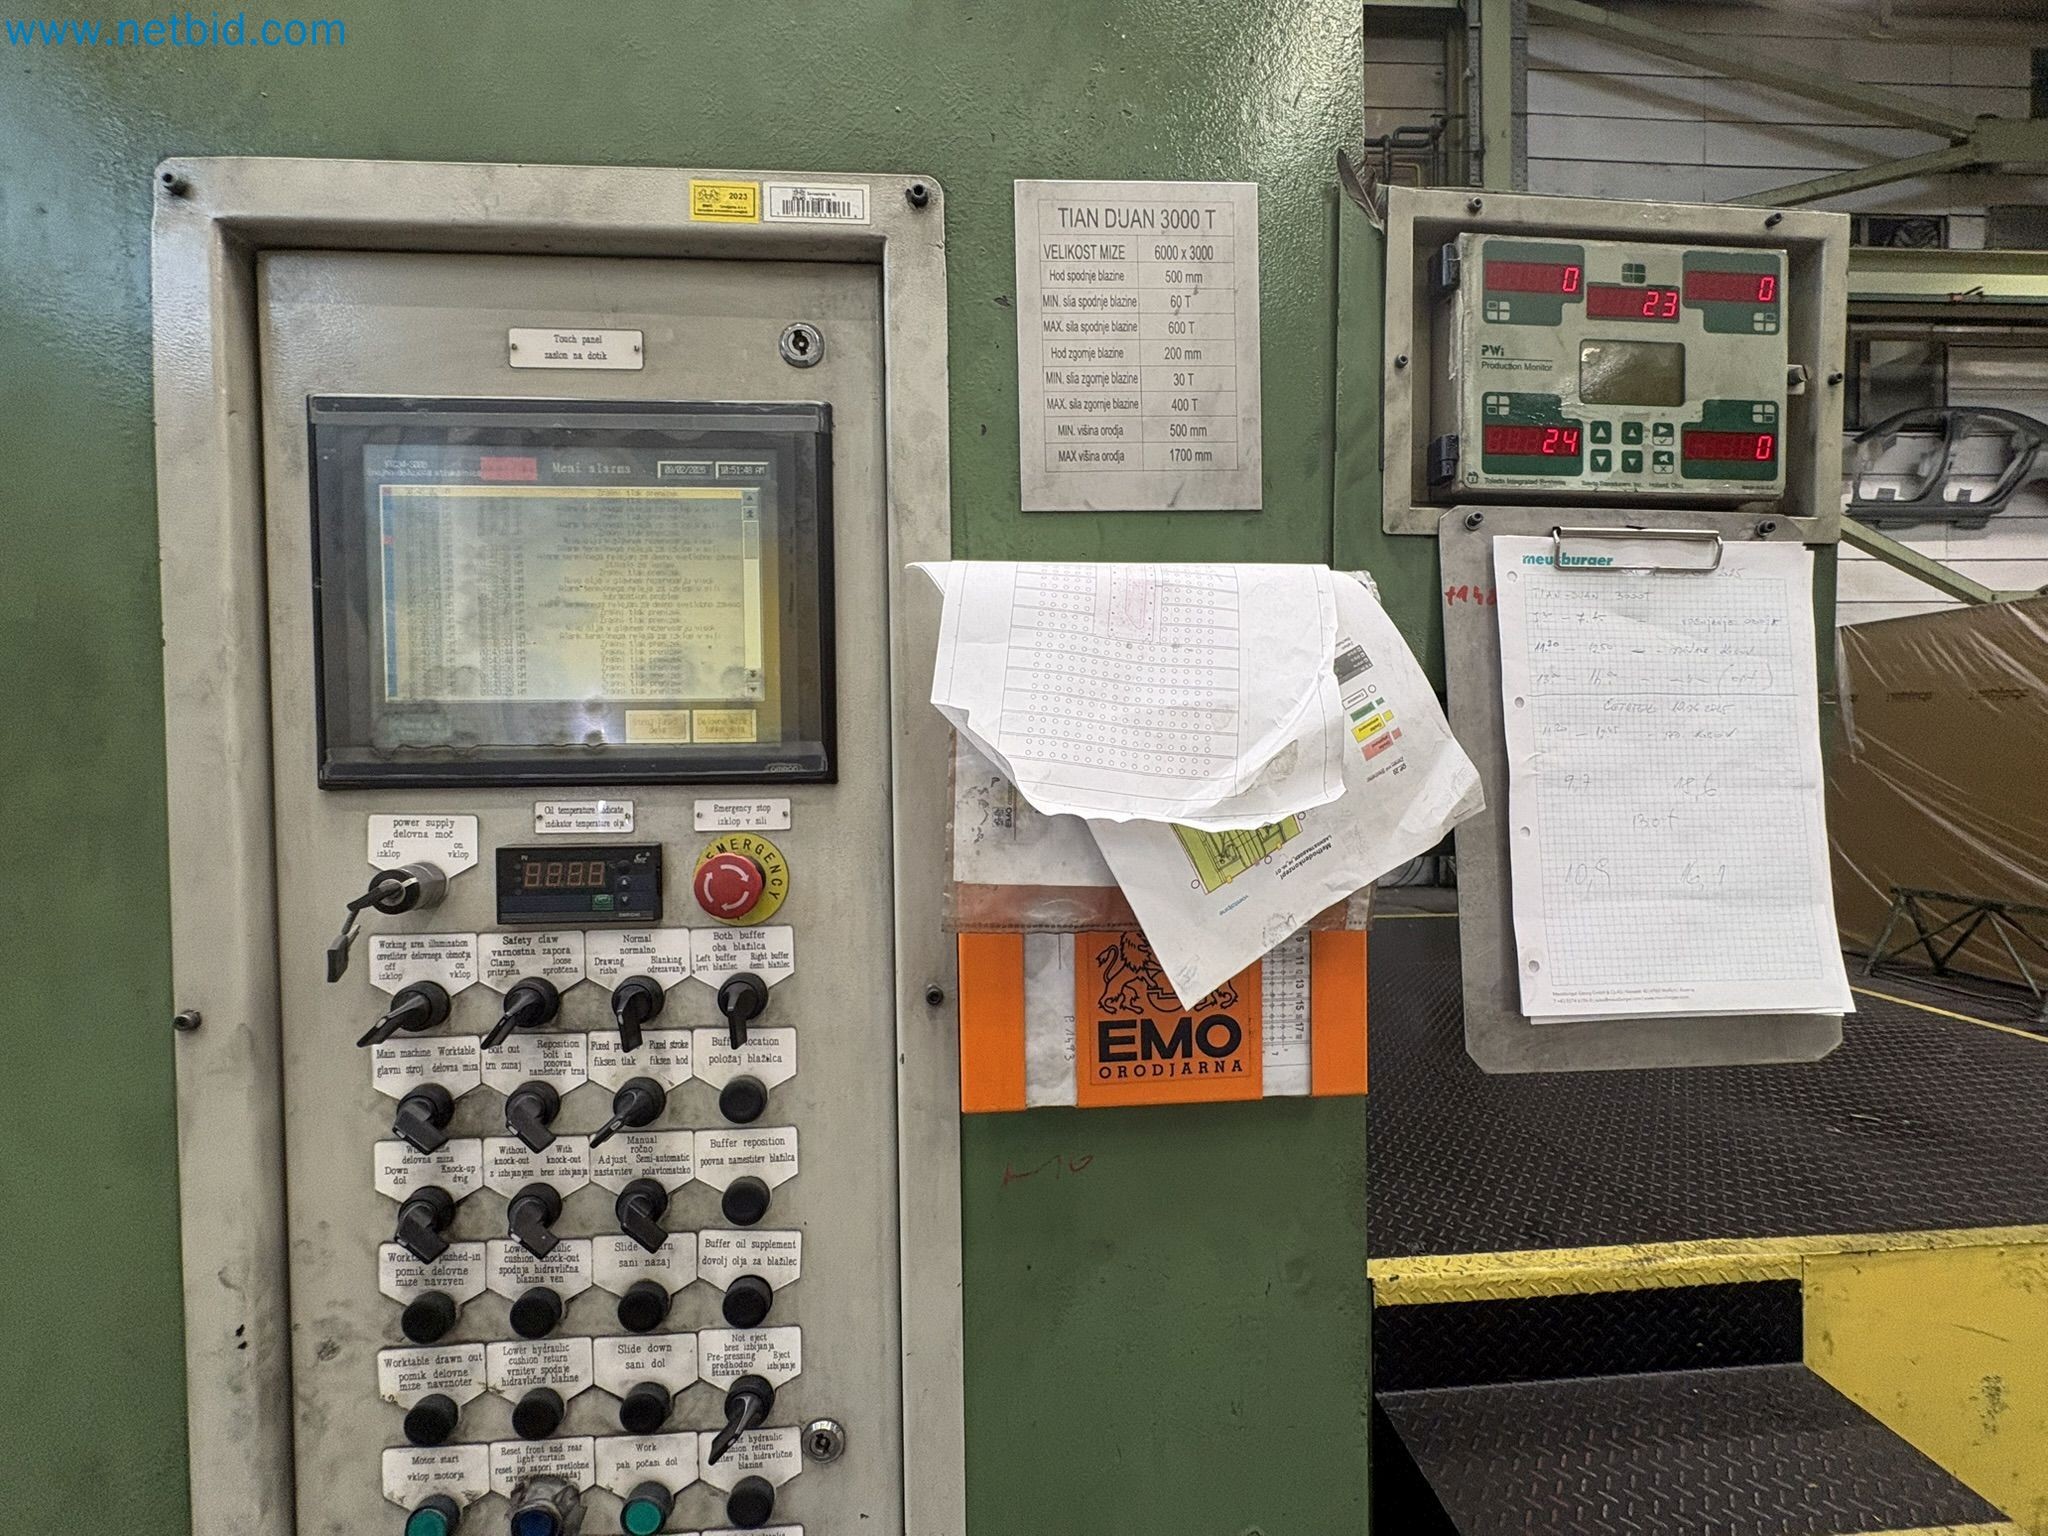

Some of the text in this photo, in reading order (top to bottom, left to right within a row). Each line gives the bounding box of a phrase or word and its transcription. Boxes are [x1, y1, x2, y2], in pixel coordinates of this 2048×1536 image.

[728, 192, 748, 200] 2023
[1058, 207, 1216, 230] TIAN DUAN 3000 T
[1043, 244, 1126, 260] VELIKOST MIZE
[1154, 245, 1179, 260] 6000
[1189, 245, 1214, 261] 3000
[1049, 269, 1125, 284] Hod spodnje blazine
[1164, 271, 1203, 283] 500 mm
[1562, 267, 1580, 292] 0
[1758, 276, 1775, 301] 0
[1042, 295, 1060, 307] MIN.
[1078, 295, 1109, 311] spodnje
[1110, 295, 1137, 307] blazine
[1170, 295, 1191, 308] 60 T
[1642, 291, 1678, 317] 23
[1043, 321, 1138, 335] MAX. sila spodnje blazine
[1168, 322, 1195, 334] 600 T
[553, 334, 602, 345] Touch panel
[544, 352, 568, 360] zaslon
[587, 351, 607, 360] dotik
[1050, 347, 1124, 361] Hod zgornje blazine
[1164, 347, 1202, 360] 200 mm
[1481, 361, 1553, 372] Production Monitor
[1045, 372, 1064, 384] MIN.
[1080, 373, 1110, 388] zgornje
[1111, 372, 1139, 384] blazine
[1173, 373, 1195, 386] 30 T
[1046, 398, 1139, 413] MAX. sila zgornje blazine
[1171, 399, 1199, 411] 400 T
[1057, 424, 1124, 439] MIN. višina orodja
[1169, 425, 1207, 437] 500 mm
[1542, 429, 1578, 454] 24
[1755, 435, 1772, 460] 0
[1058, 451, 1125, 465] MAX višina orodja
[1169, 449, 1212, 462] 1700 mm
[713, 804, 771, 814] Emergency stop
[393, 818, 455, 829] power supply
[393, 830, 428, 839] delovna
[382, 840, 394, 849] off
[447, 851, 469, 861] vklop
[502, 934, 559, 946] Safety claw
[622, 934, 652, 944] Normal
[713, 931, 766, 940] Both buffer
[491, 947, 571, 957] varnostna zapora
[619, 945, 656, 955] normalno
[712, 942, 727, 952] oba
[594, 957, 625, 967] Drawing
[651, 955, 683, 965] Blanking
[696, 953, 737, 962] Left buffer
[384, 962, 396, 971] off
[490, 959, 515, 968] Clamp
[449, 971, 471, 979] vklop
[1295, 979, 1304, 989] 13
[1295, 1000, 1304, 1011] 15
[1295, 1022, 1304, 1032] 17
[1098, 1013, 1242, 1063] EMO
[507, 1045, 520, 1054] out
[543, 1050, 559, 1059] bolt
[709, 1055, 742, 1066] položaj
[1099, 1059, 1243, 1079] ORODJARNA
[627, 1136, 657, 1145] Manual
[710, 1138, 786, 1149] Buffer reposition
[556, 1145, 573, 1153] With
[402, 1156, 432, 1164] delovna
[598, 1155, 628, 1166] Adjust
[384, 1167, 409, 1175] Down
[393, 1176, 406, 1185] dol
[614, 1241, 638, 1252] Slide
[705, 1239, 796, 1250] Buffer oil supplement
[504, 1254, 534, 1263] cushion
[644, 1258, 671, 1268] nazaj
[702, 1256, 748, 1268] dovolj olja
[395, 1266, 469, 1278] pomik delovne
[424, 1277, 464, 1286] navzven
[732, 1334, 745, 1342] Not
[503, 1346, 527, 1356] Lower
[617, 1343, 672, 1354] Slide down
[435, 1353, 483, 1364] drawn out
[544, 1354, 568, 1363] return
[651, 1359, 666, 1368] dol
[433, 1368, 469, 1379] delovne
[501, 1445, 544, 1456] Reset front
[635, 1443, 657, 1452] Work
[412, 1455, 459, 1464] Motor start
[665, 1457, 678, 1466] dol
[407, 1473, 429, 1482] vklop
